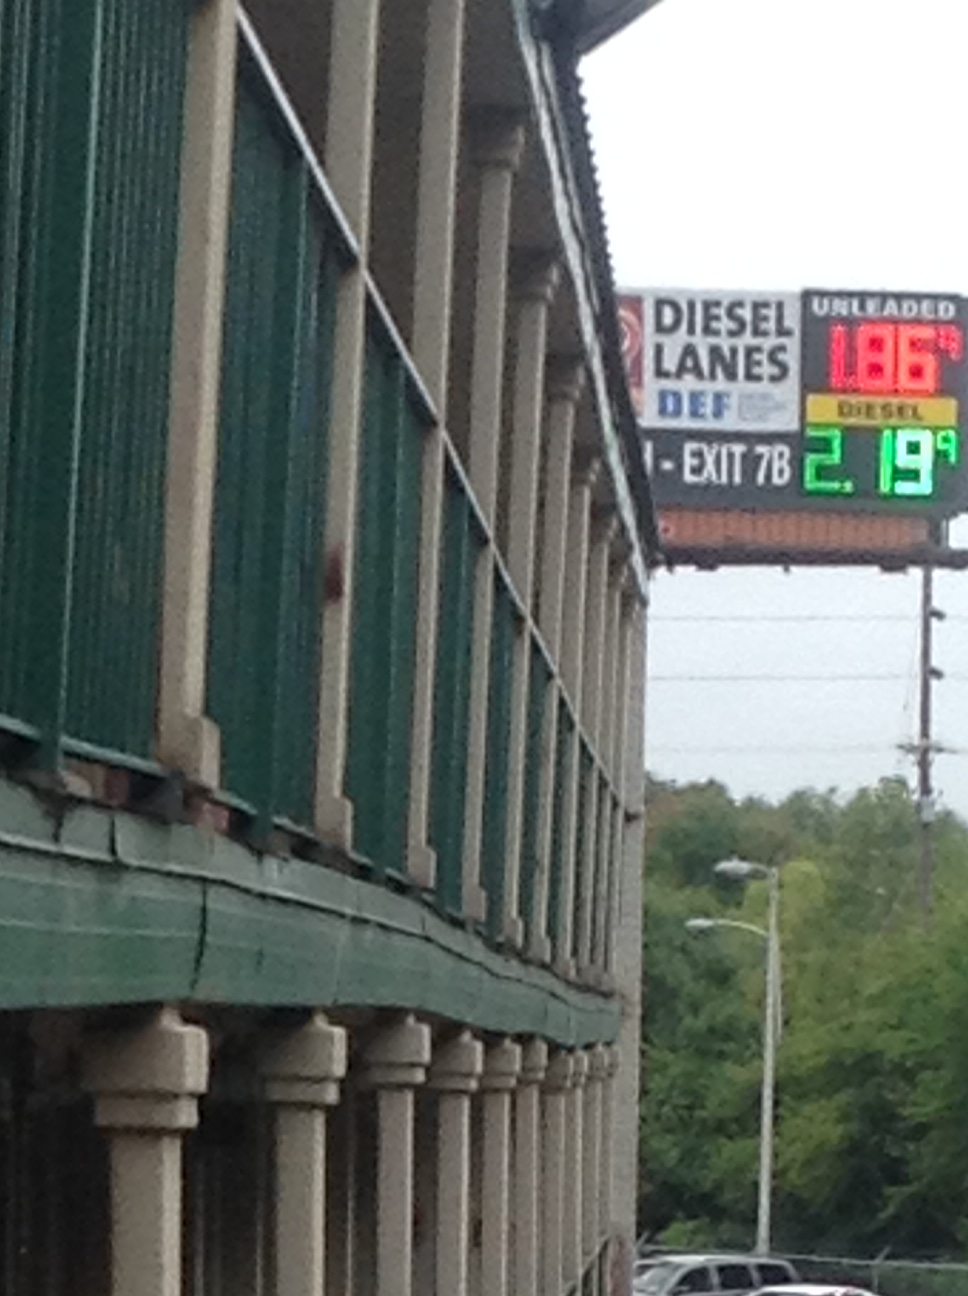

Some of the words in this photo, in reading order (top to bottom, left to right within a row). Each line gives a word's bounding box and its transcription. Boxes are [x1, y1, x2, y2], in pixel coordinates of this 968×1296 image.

[654, 298, 793, 338] DIESEL
[812, 296, 956, 320] UNLEADED
[654, 343, 789, 383] LANES
[658, 389, 730, 419] DEF
[838, 401, 924, 420] DIESEL
[683, 441, 747, 485] EXIT
[755, 444, 791, 487] 7B
